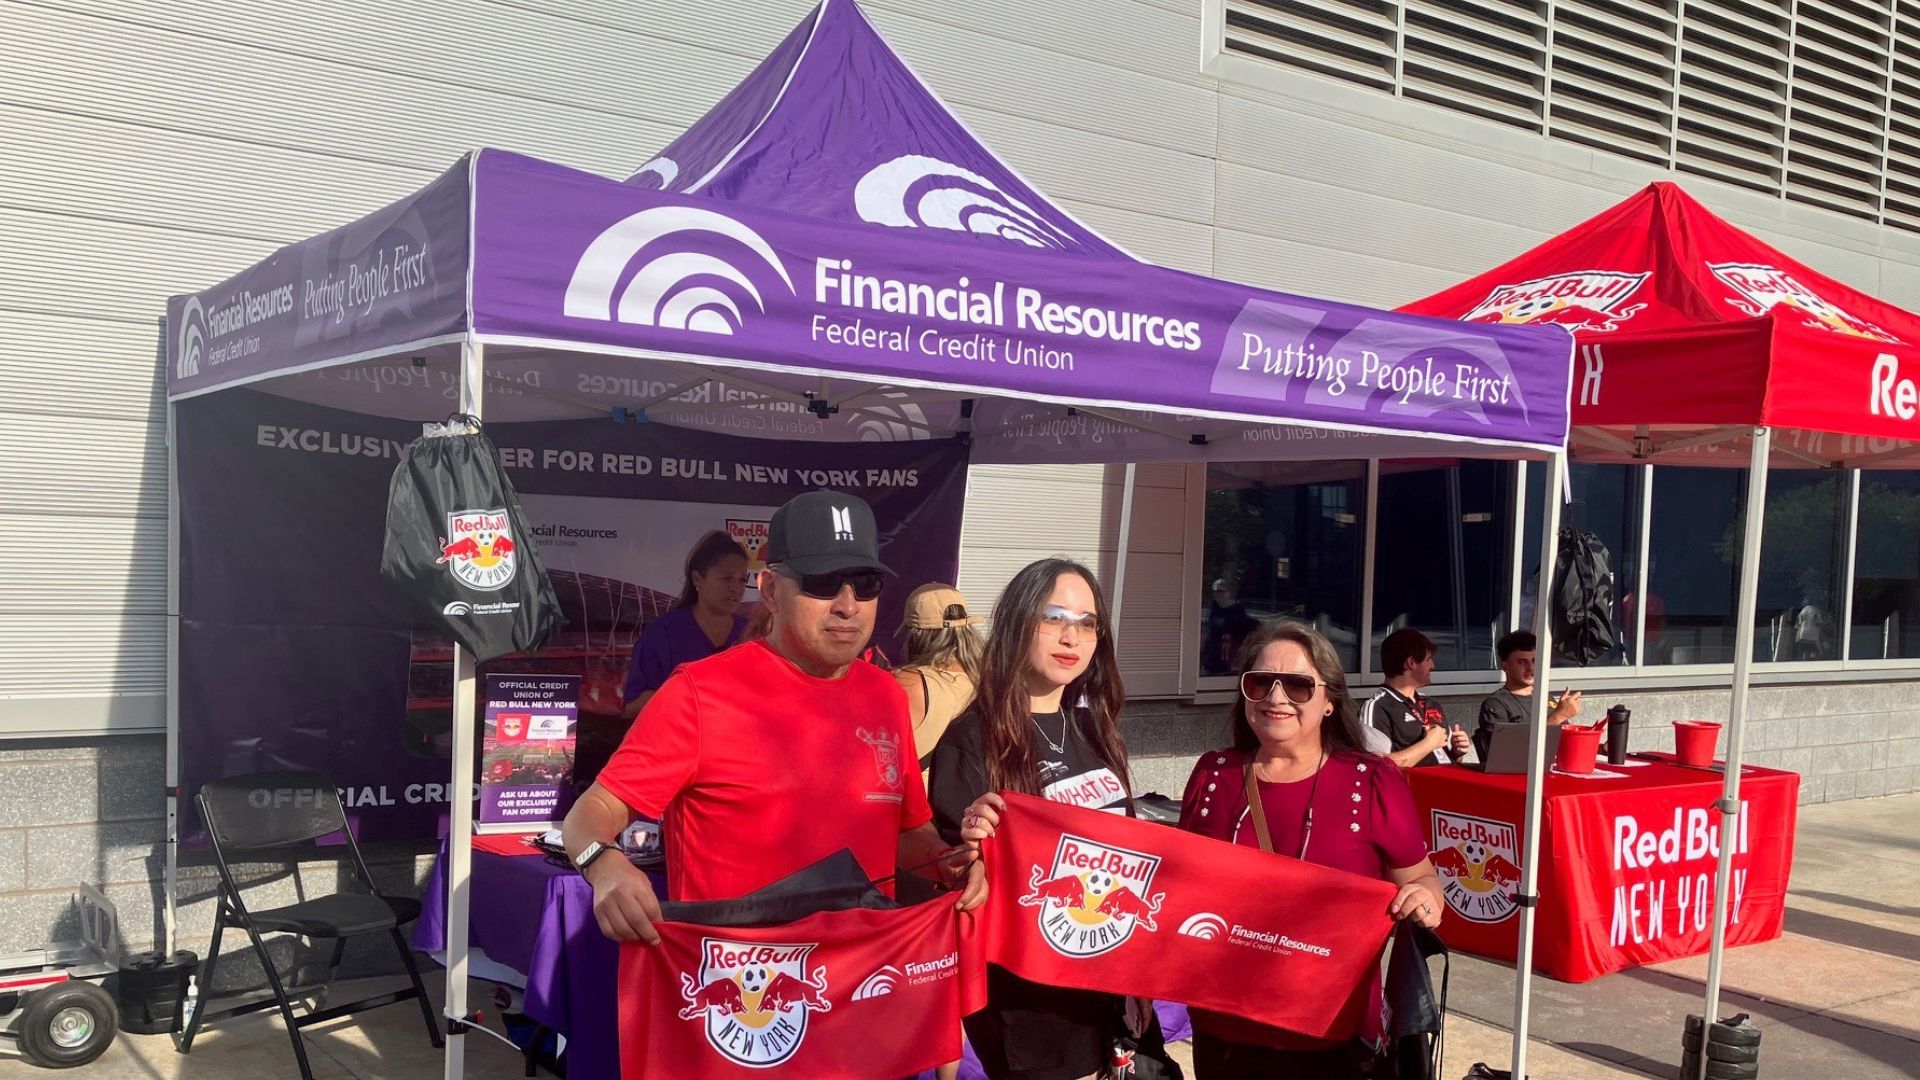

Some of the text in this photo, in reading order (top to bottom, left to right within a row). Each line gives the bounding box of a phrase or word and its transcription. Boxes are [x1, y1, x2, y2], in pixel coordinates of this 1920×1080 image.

[303, 242, 428, 325] Putting People First
[1483, 279, 1633, 309] Red Bull
[1723, 271, 1789, 294] Red
[207, 282, 294, 340] Financial Resources
[815, 256, 1201, 351] Financial Resources
[227, 338, 244, 360] Credit
[243, 335, 260, 356] Union
[811, 315, 1074, 371] Federal Credit Union
[1238, 332, 1512, 405] Putting People First
[1870, 352, 1918, 420] Re
[256, 424, 410, 462] EXCLUSIV
[543, 449, 594, 472] FOR
[602, 453, 652, 475] RED
[660, 457, 727, 480] BULL
[735, 462, 788, 484] NEW
[795, 468, 862, 487] YORK
[866, 469, 919, 487] FANS
[455, 516, 483, 532] Red
[559, 525, 618, 539] Resources
[729, 522, 754, 537] Red
[835, 533, 854, 541] BTS
[459, 560, 512, 585] NEW YORK
[499, 681, 570, 690] OFFICIAL CREDIT
[513, 691, 555, 699] UNION OF
[489, 700, 576, 709] RED BULL NEW YORK
[497, 799, 558, 807] OUR EXCLUSIVE
[500, 790, 557, 799] ASK US ABOUT
[1049, 775, 1120, 806] WHAT IS
[502, 808, 518, 816] FAN
[1437, 817, 1512, 850] Red Bull
[1613, 800, 1749, 870] Red Bul
[1060, 842, 1152, 882] Red Bull
[1443, 880, 1512, 916] NEW YORK
[1610, 867, 1747, 947] NEW YOK
[1046, 910, 1121, 950] NEW YORK
[1231, 924, 1331, 957] Financial Resources
[709, 944, 803, 969] Red Bull
[1227, 936, 1292, 956] Federal Credit Union
[904, 951, 955, 977] Financial
[908, 972, 937, 986] Federal
[717, 1017, 798, 1058] NEW YORK
